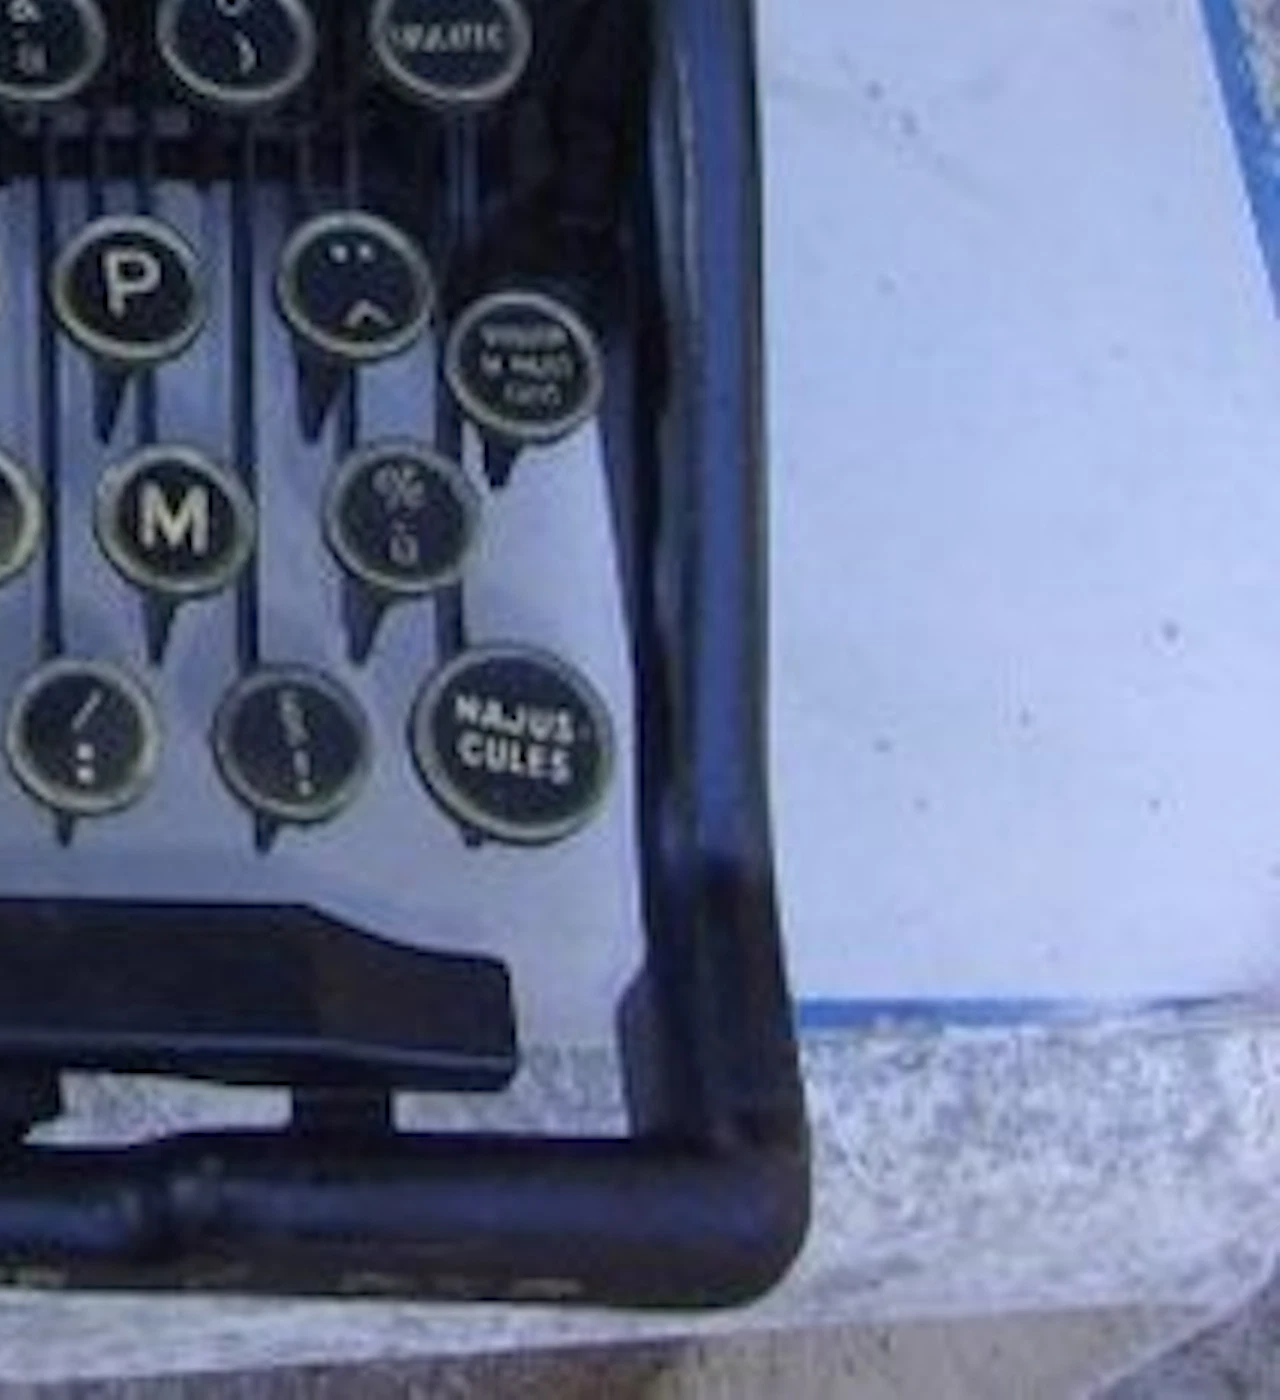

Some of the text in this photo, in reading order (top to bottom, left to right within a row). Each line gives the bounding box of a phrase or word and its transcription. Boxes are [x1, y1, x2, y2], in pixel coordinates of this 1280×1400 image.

[101, 248, 162, 318] P
[141, 480, 210, 554] M
[457, 730, 572, 785] CULES
